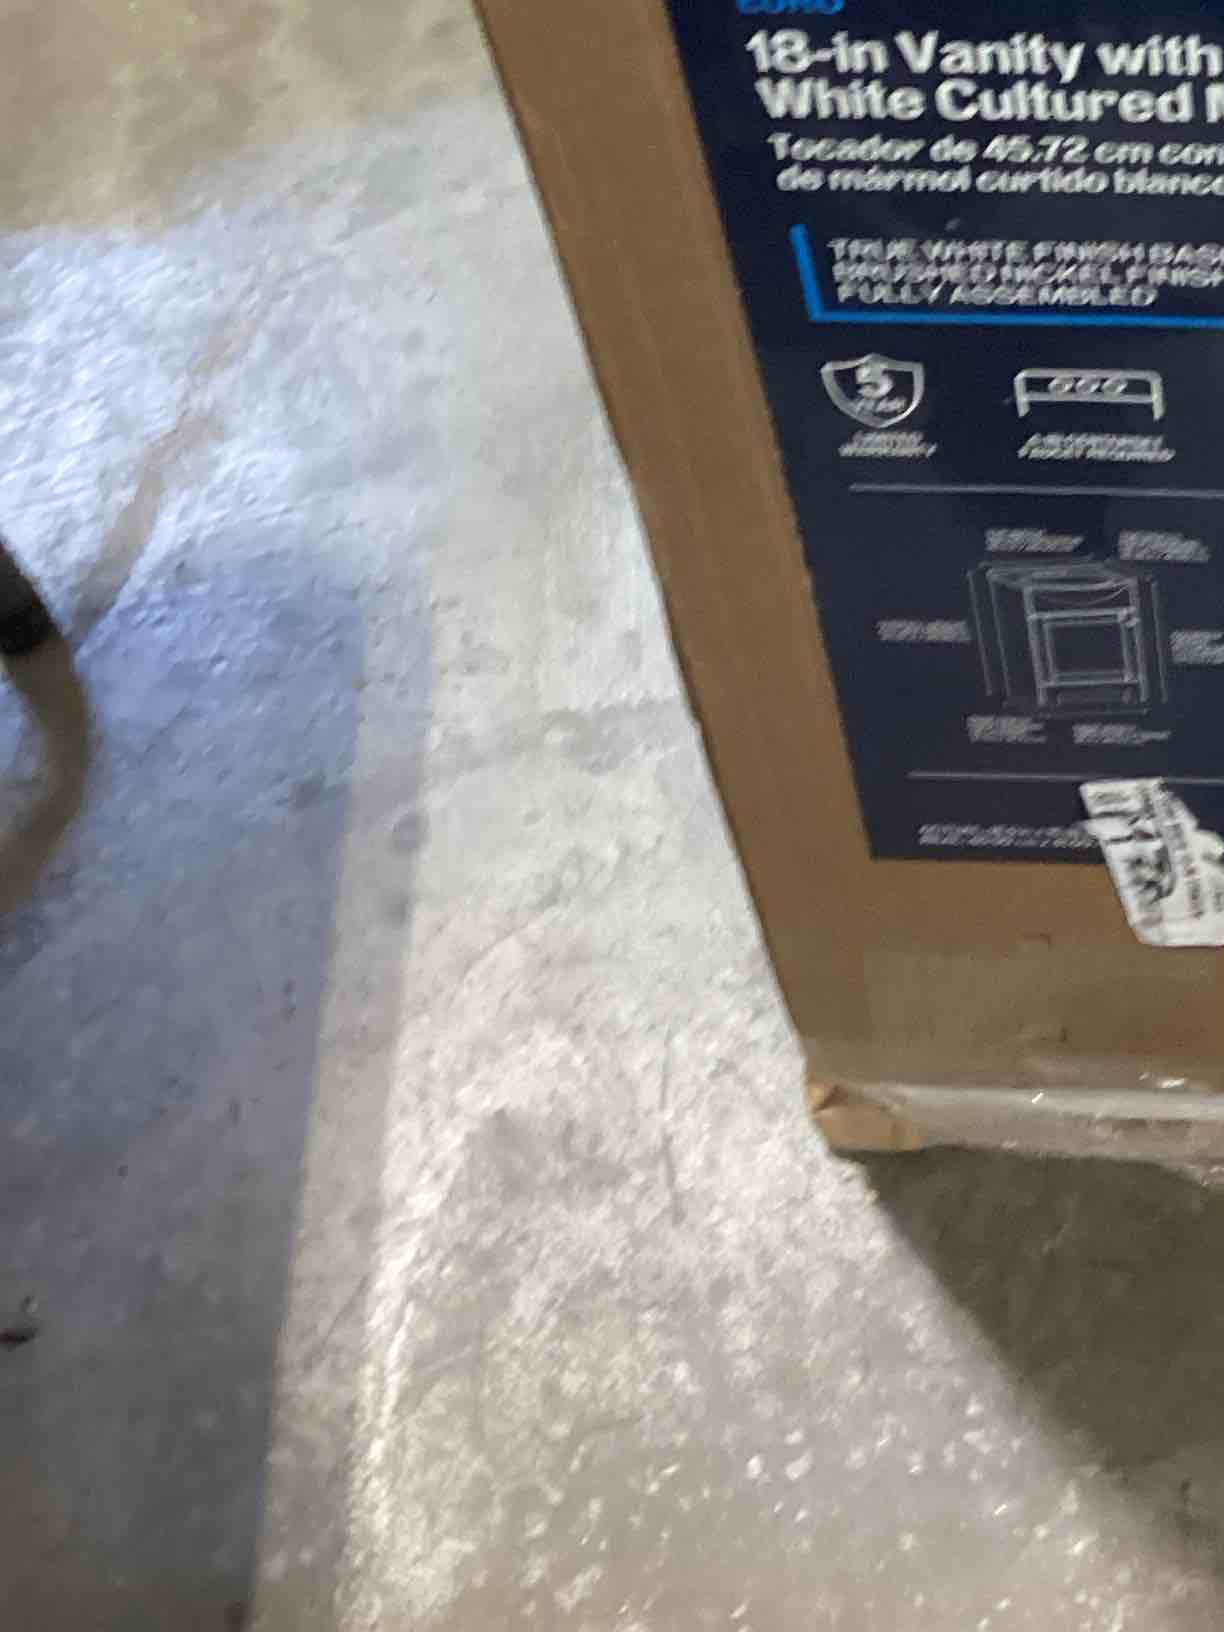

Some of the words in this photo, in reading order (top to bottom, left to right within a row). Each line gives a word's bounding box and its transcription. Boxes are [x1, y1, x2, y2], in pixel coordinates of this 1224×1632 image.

[746, 28, 890, 74] 18-in
[894, 29, 1086, 84] Vanity
[1097, 33, 1224, 77] with
[754, 76, 927, 120] White
[934, 78, 1195, 123] Cultured
